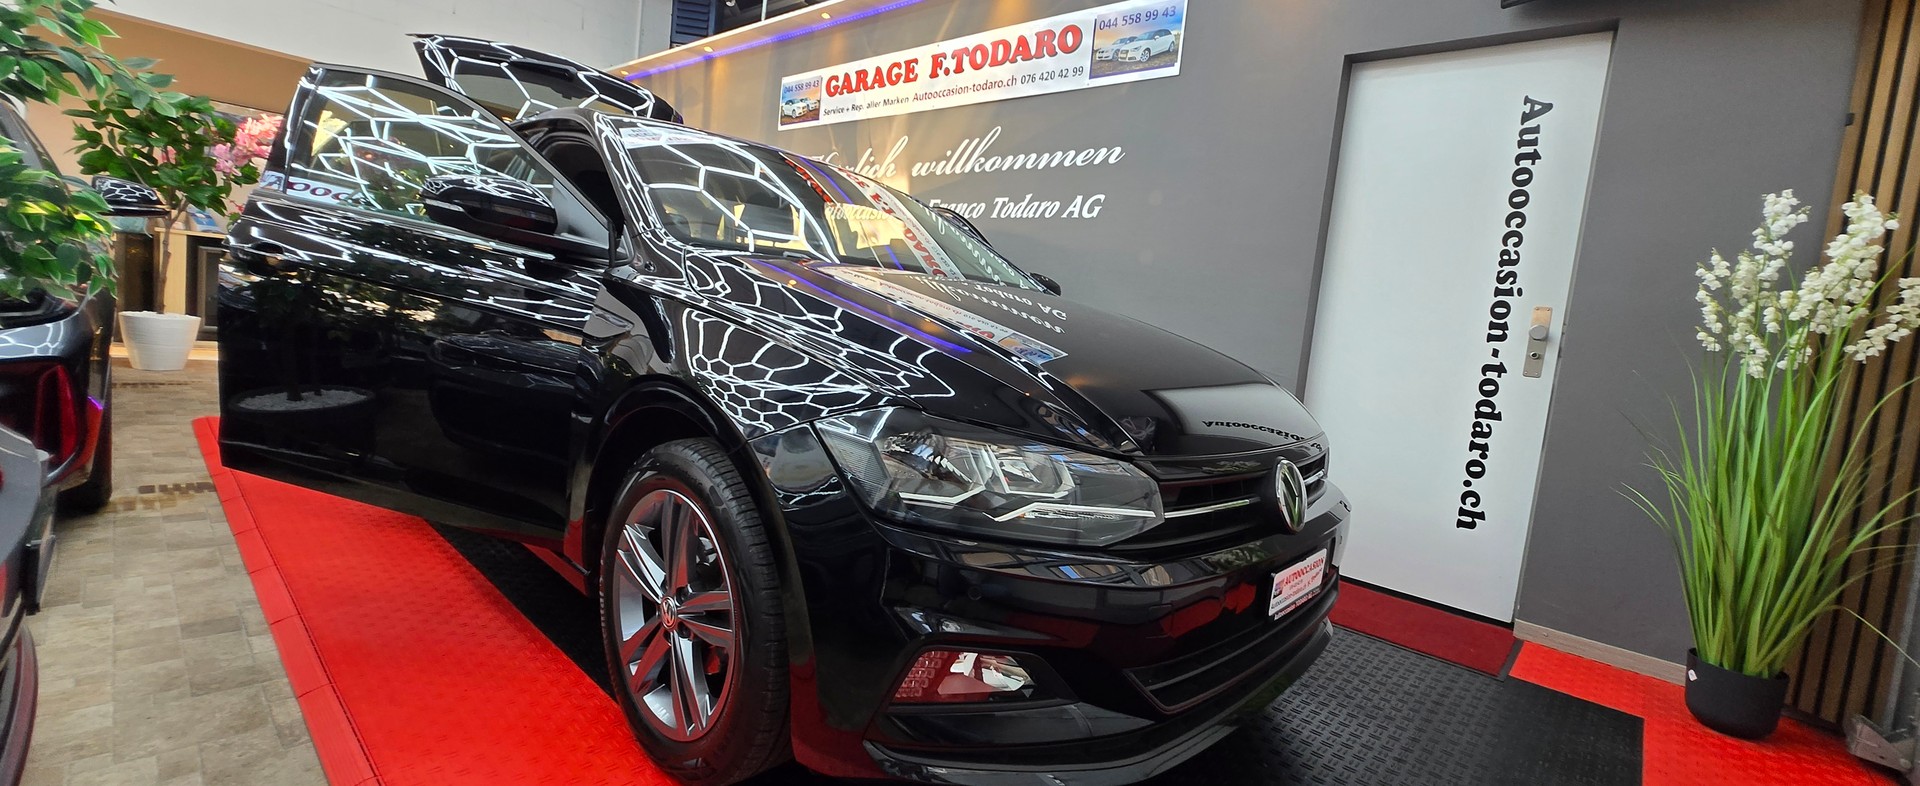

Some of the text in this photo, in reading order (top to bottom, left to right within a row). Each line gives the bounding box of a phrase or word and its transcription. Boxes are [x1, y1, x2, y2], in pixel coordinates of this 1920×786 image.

[1099, 5, 1176, 31] 044 558 99 43
[812, 79, 820, 88] 43
[825, 24, 1083, 98] GARAGE F.TODARO
[823, 106, 845, 116] Service
[866, 98, 881, 109] aller
[882, 96, 910, 107] Marken
[912, 76, 1017, 102] Autooccasion-todaro.ch
[1020, 73, 1037, 85] 076
[1038, 70, 1056, 82] 420
[1057, 68, 1071, 80] 42
[1072, 66, 1084, 77] 99
[911, 125, 1126, 178] willkommen
[990, 193, 1061, 219] Todaro
[1061, 193, 1106, 219] AG
[1456, 95, 1554, 530] Autooccasion-todaro.ch
